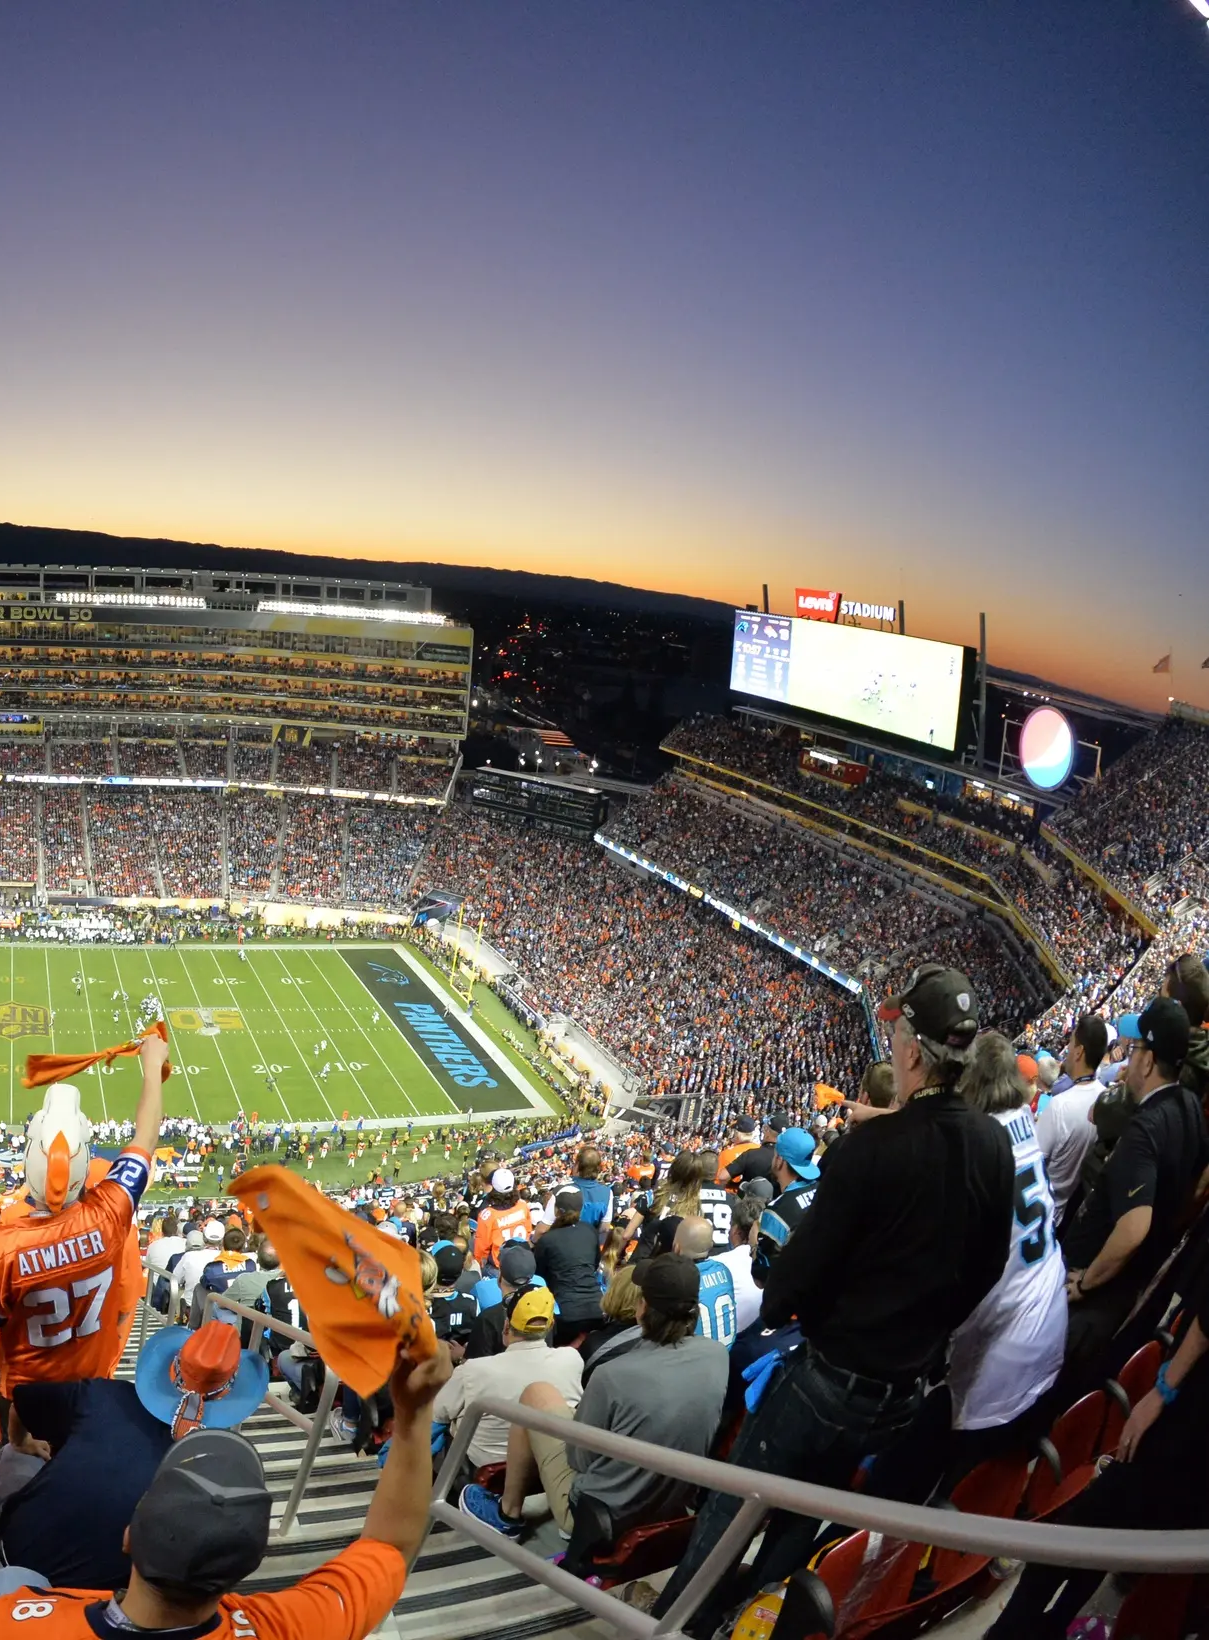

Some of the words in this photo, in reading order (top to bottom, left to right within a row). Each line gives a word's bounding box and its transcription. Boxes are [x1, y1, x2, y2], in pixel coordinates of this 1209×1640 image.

[10, 606, 64, 621] BOWL
[69, 607, 93, 621] 50
[840, 600, 896, 622] STADIUM
[394, 1002, 499, 1089] PANTHERS
[251, 1064, 283, 1075] 20
[334, 1061, 362, 1073] 10
[646, 1101, 676, 1118] 50
[18, 1230, 106, 1276] ATWATER
[23, 1266, 114, 1348] 27
[11, 1598, 58, 1621] 18
